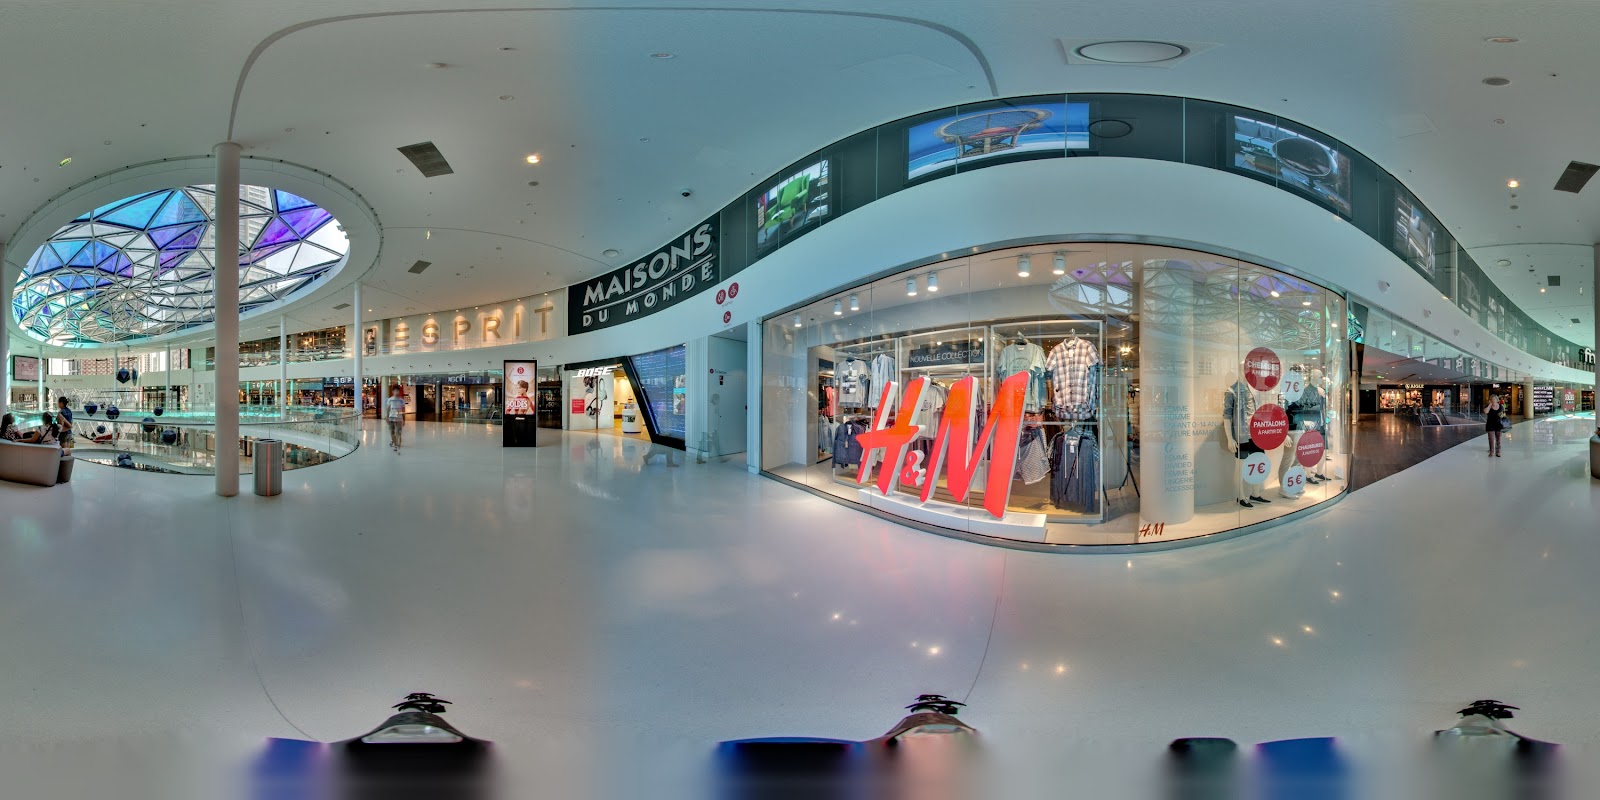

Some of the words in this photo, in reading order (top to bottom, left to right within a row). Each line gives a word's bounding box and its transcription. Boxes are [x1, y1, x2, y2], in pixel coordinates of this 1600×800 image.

[583, 223, 714, 307] MAISONS
[582, 309, 611, 328] DU
[625, 262, 714, 317] MONDE
[394, 305, 554, 348] ESPRIT
[910, 353, 941, 363] NOUVELLE
[941, 349, 984, 361] COLLECTION
[572, 365, 618, 379] BOSE
[506, 400, 528, 408] SOLDES
[1253, 420, 1286, 428] PANTALONS
[855, 370, 1031, 520] H&M
[1165, 484, 1207, 493] ACCESSO
